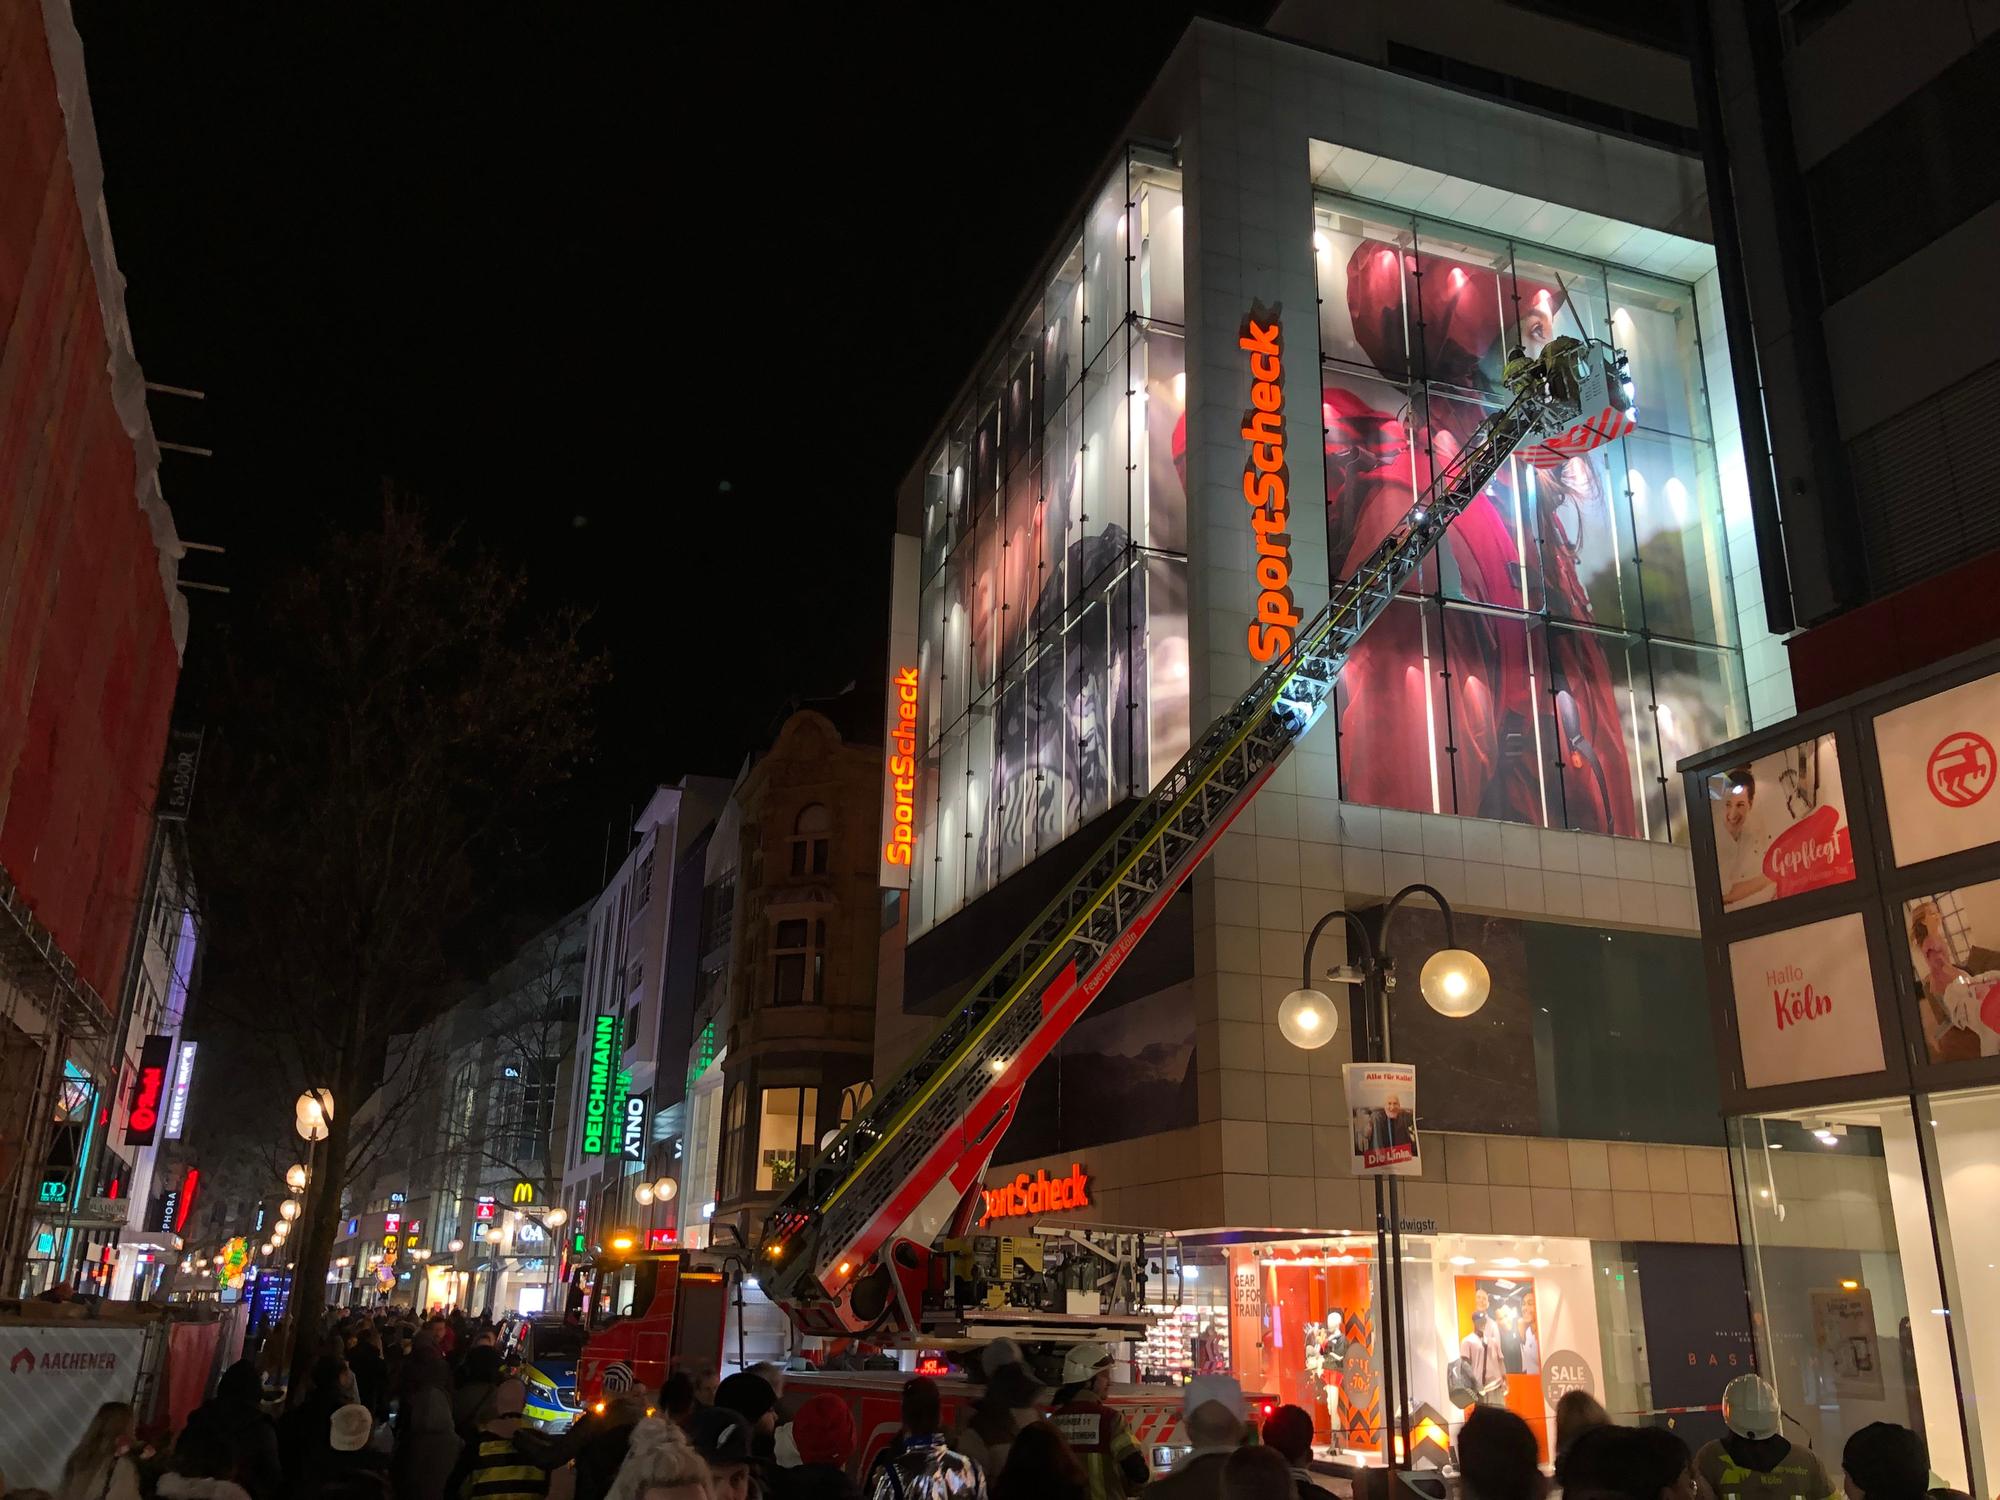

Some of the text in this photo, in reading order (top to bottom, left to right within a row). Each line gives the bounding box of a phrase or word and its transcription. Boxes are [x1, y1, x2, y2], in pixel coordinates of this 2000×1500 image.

[1239, 319, 1298, 665] SportScheck
[886, 667, 918, 866] SportScheck
[1771, 829, 1841, 877] Gepflegt
[1082, 931, 1137, 995] Feuerwehr Köln
[1766, 964, 1804, 987] Hallo
[1773, 984, 1832, 1030] Köln
[584, 1016, 614, 1153] DEICHMANN
[1366, 1073, 1382, 1081] Alle
[1383, 1073, 1394, 1081] für
[624, 1098, 644, 1158] ONLY
[1368, 1151, 1385, 1165] Die
[978, 1162, 1089, 1227] portScheck
[1387, 1218, 1438, 1233] Ldwigstr.
[1234, 1274, 1256, 1287] GEAR
[1234, 1288, 1264, 1303] UP FOR
[40, 1352, 117, 1370] AACHENER
[1551, 1365, 1585, 1381] SALE
